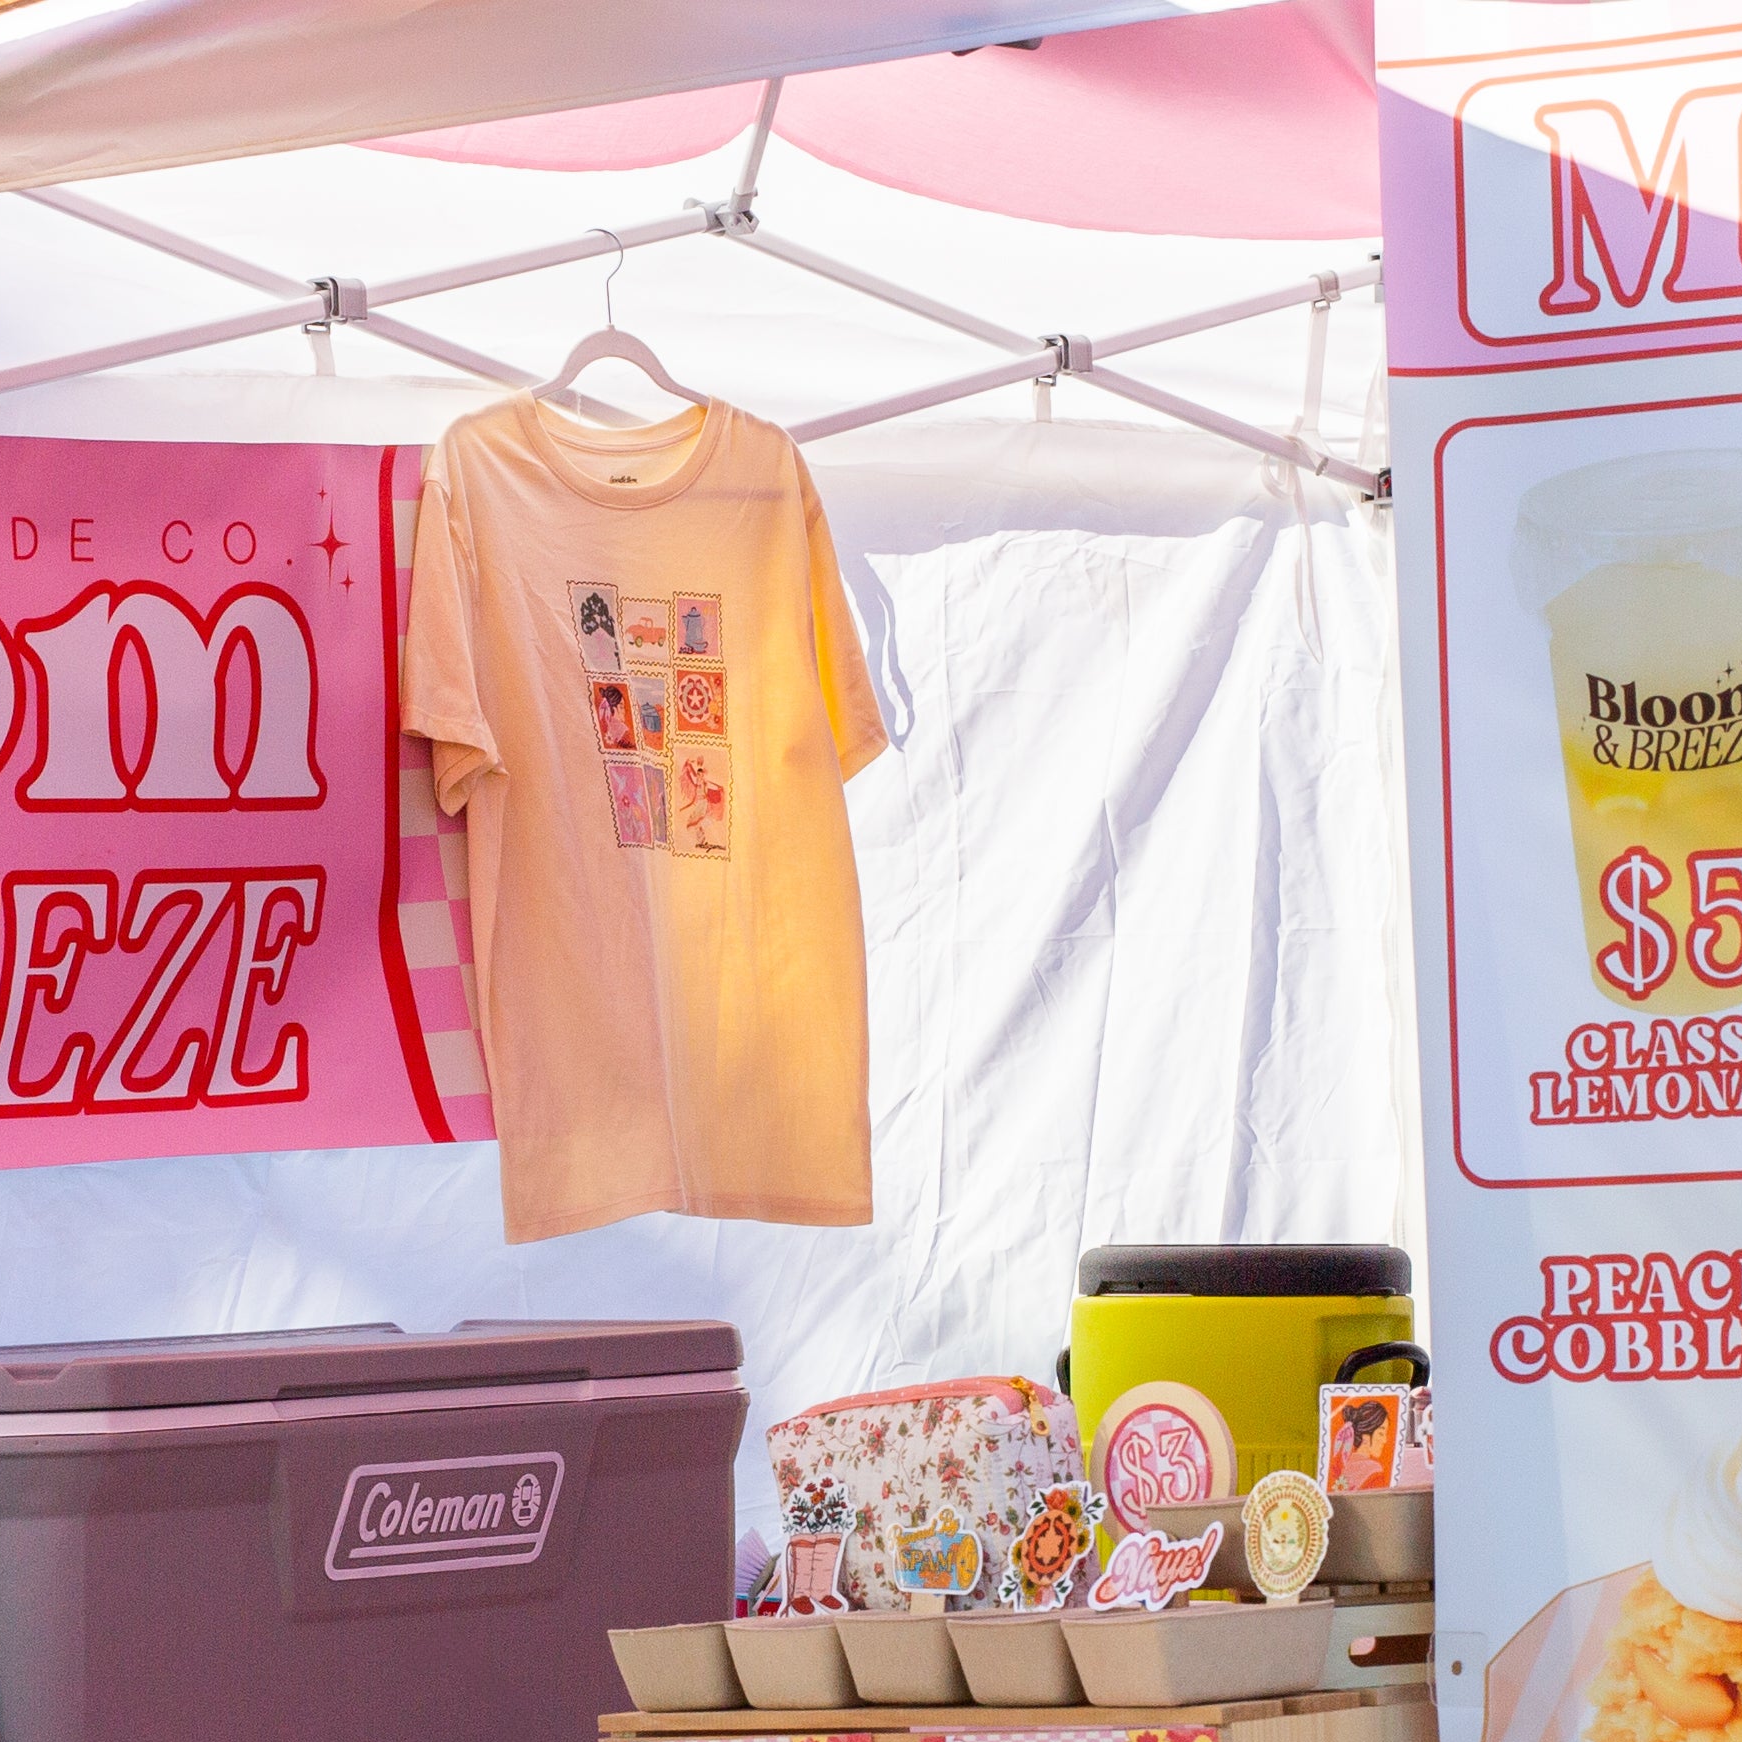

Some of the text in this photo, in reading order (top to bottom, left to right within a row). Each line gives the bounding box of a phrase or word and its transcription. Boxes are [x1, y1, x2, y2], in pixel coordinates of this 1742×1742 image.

[162, 517, 300, 570] CO.
[1593, 724, 1623, 769] &
[1118, 1426, 1199, 1520] $3
[358, 1480, 506, 1542] Coleman
[896, 1549, 956, 1574] SPAM
